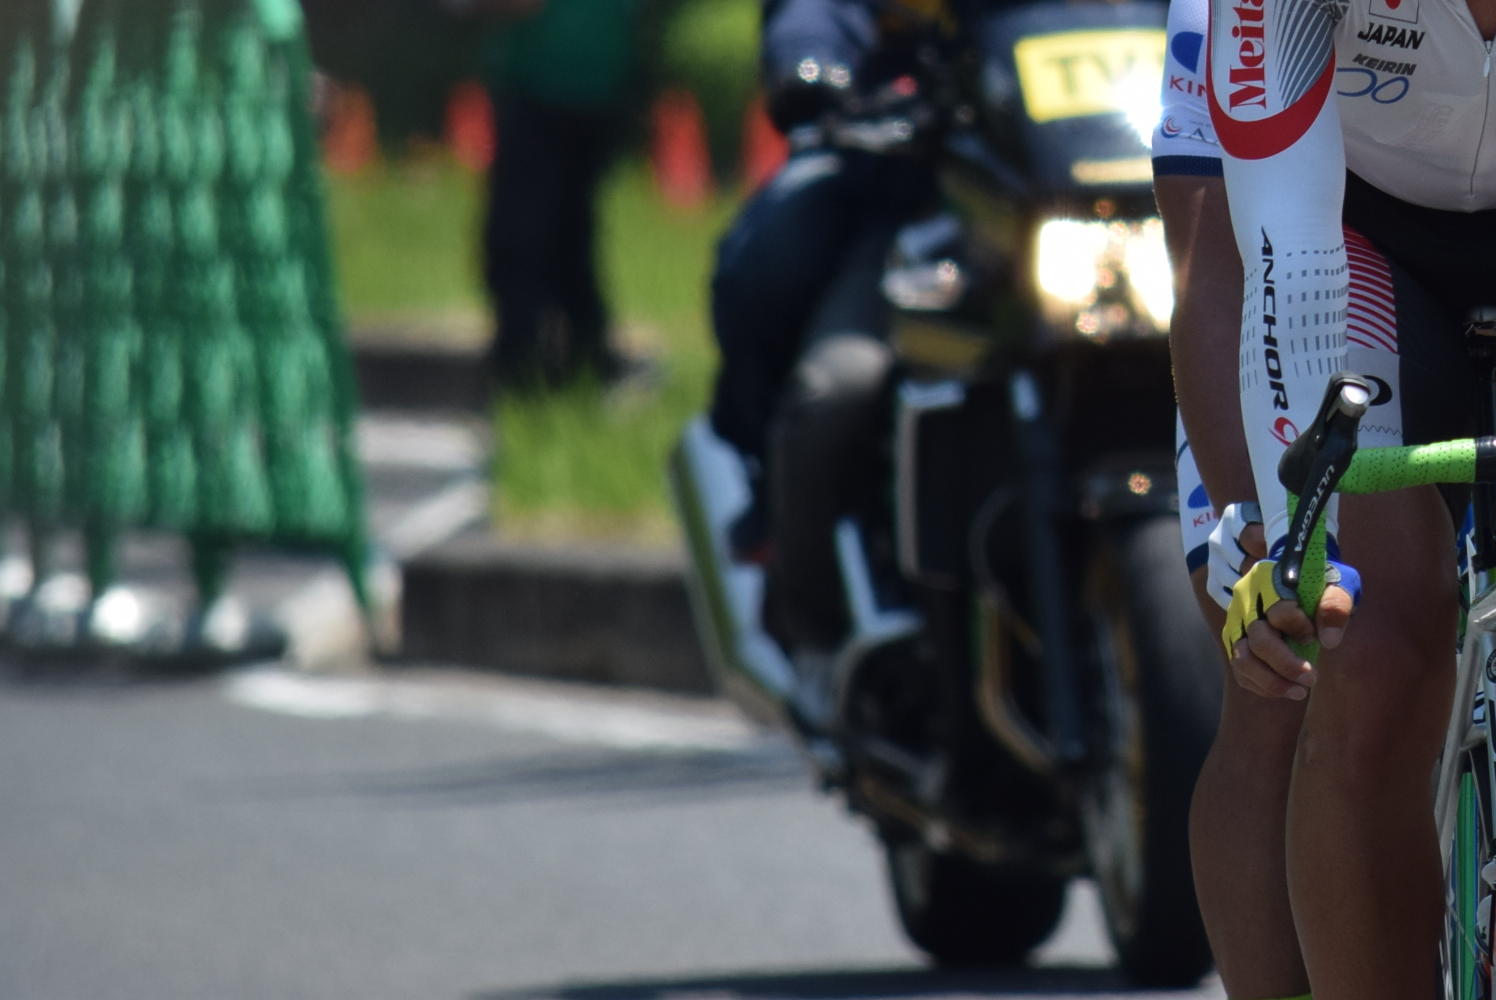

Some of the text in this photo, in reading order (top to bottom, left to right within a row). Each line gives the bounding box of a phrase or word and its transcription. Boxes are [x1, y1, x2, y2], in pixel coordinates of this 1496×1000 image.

[1352, 52, 1417, 77] KEIRIN
[1357, 22, 1426, 51] JAPAN
[1260, 225, 1290, 411] ANCHOR
[1294, 463, 1336, 553] ULTEGRA
